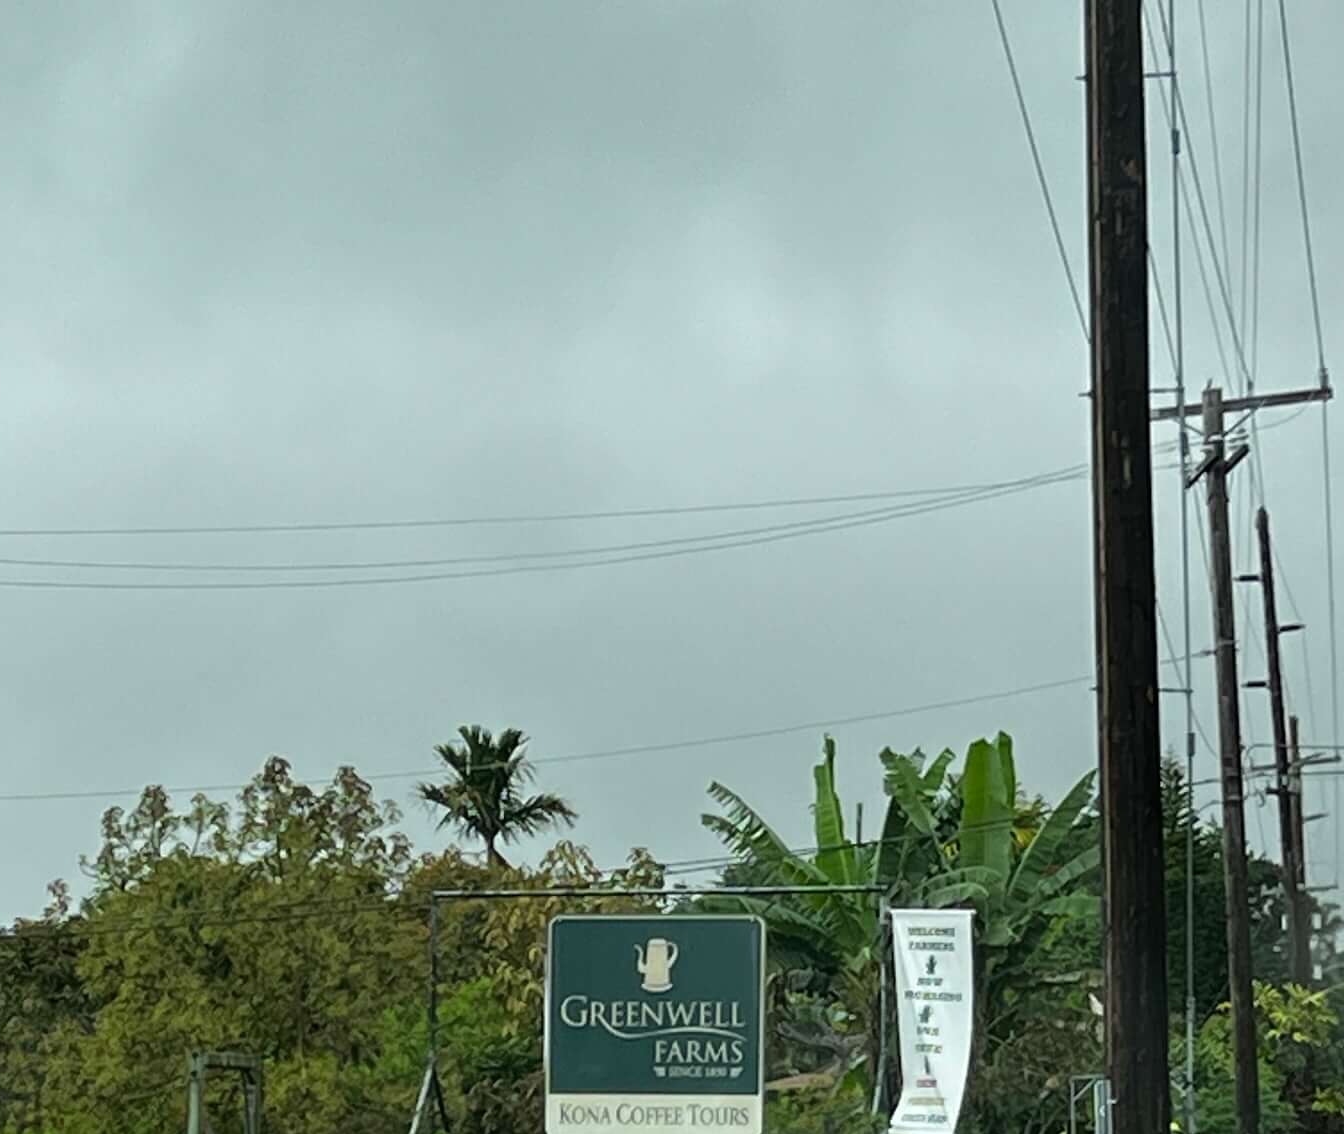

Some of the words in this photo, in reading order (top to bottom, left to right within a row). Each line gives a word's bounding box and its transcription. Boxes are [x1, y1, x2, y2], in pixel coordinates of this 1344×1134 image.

[560, 994, 746, 1031] GREENWELL
[655, 1040, 743, 1063] FARMS
[668, 1066, 703, 1078] SINCE
[687, 1104, 750, 1127] TOURS
